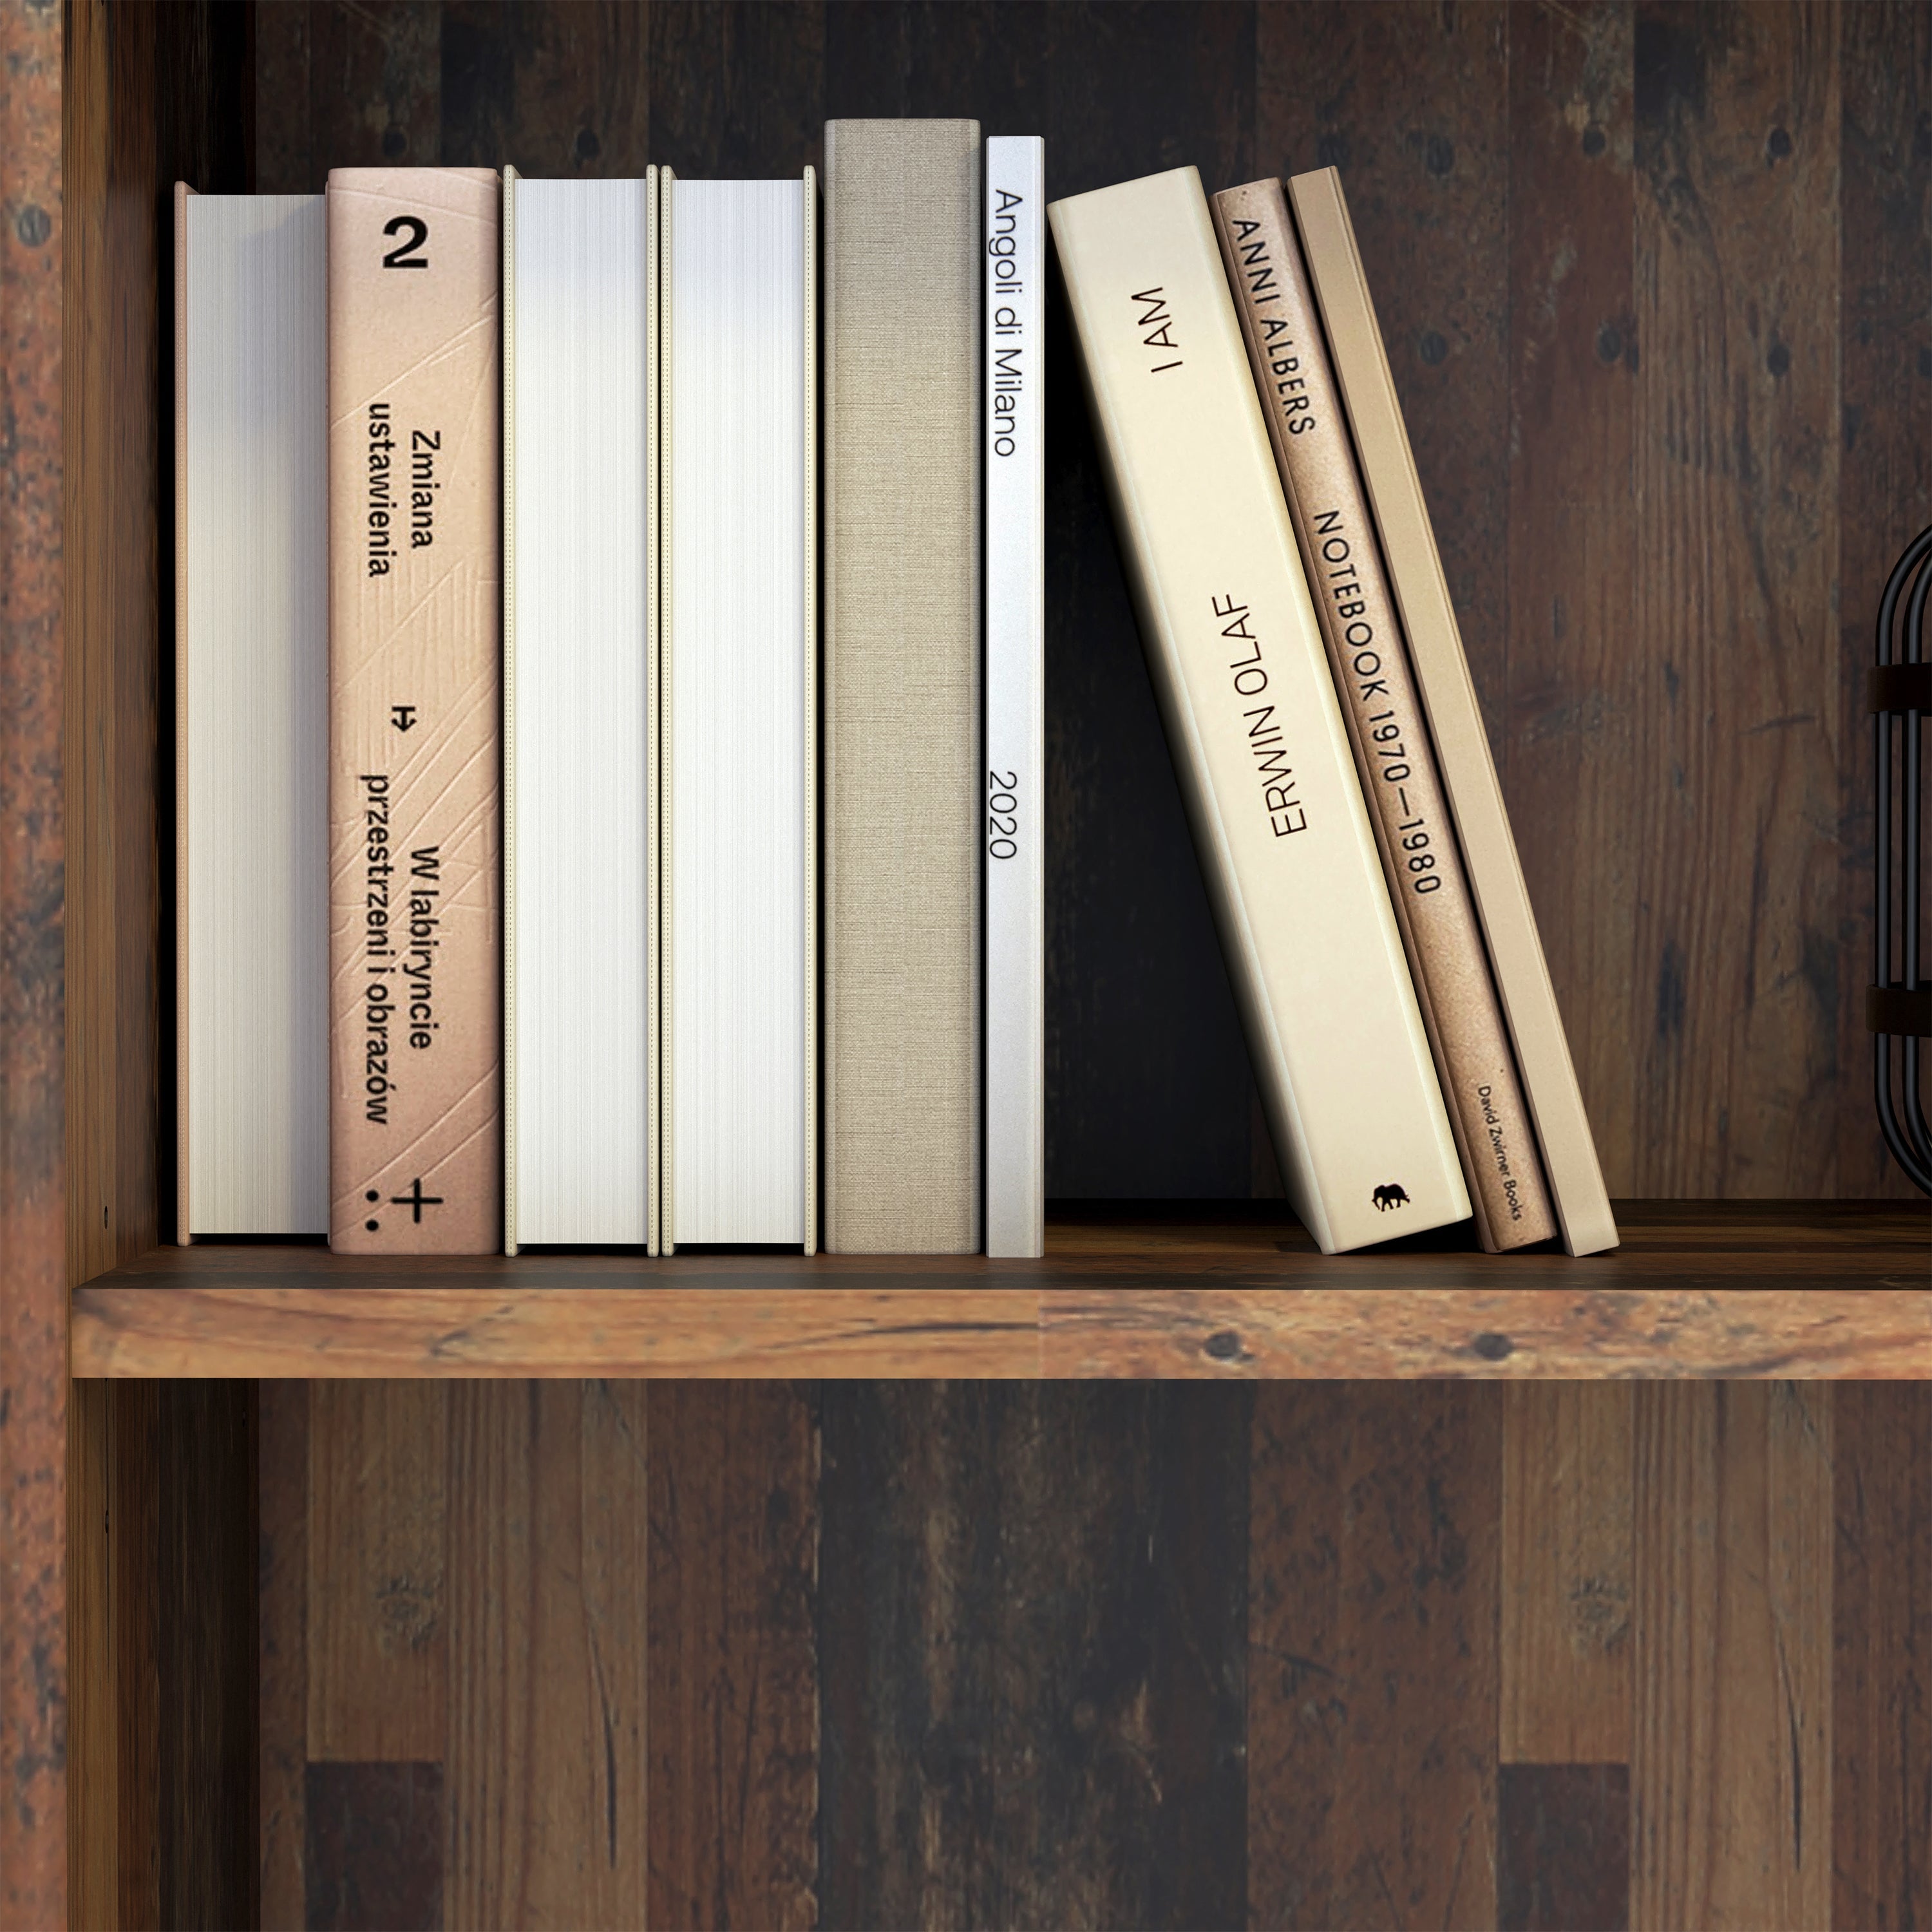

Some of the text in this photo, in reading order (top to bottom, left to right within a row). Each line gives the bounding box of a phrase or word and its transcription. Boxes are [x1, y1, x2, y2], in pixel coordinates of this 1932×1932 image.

[383, 216, 428, 268] 2
[989, 189, 1023, 457] Angoli di Milano
[1233, 218, 1315, 435] ANNI ALBERS
[1131, 287, 1183, 373] I AM
[368, 404, 397, 578] ustawienia
[412, 430, 440, 549] Zmiana
[1314, 511, 1388, 701] NOTEBOOK
[1211, 594, 1307, 837] ERWIN OLAF
[359, 775, 396, 956] przestrzeni
[989, 771, 1018, 860] 2020
[402, 846, 439, 1050] W labiryncie
[365, 983, 397, 1125] obrazów
[1478, 1085, 1522, 1221] David Zwirner Books
